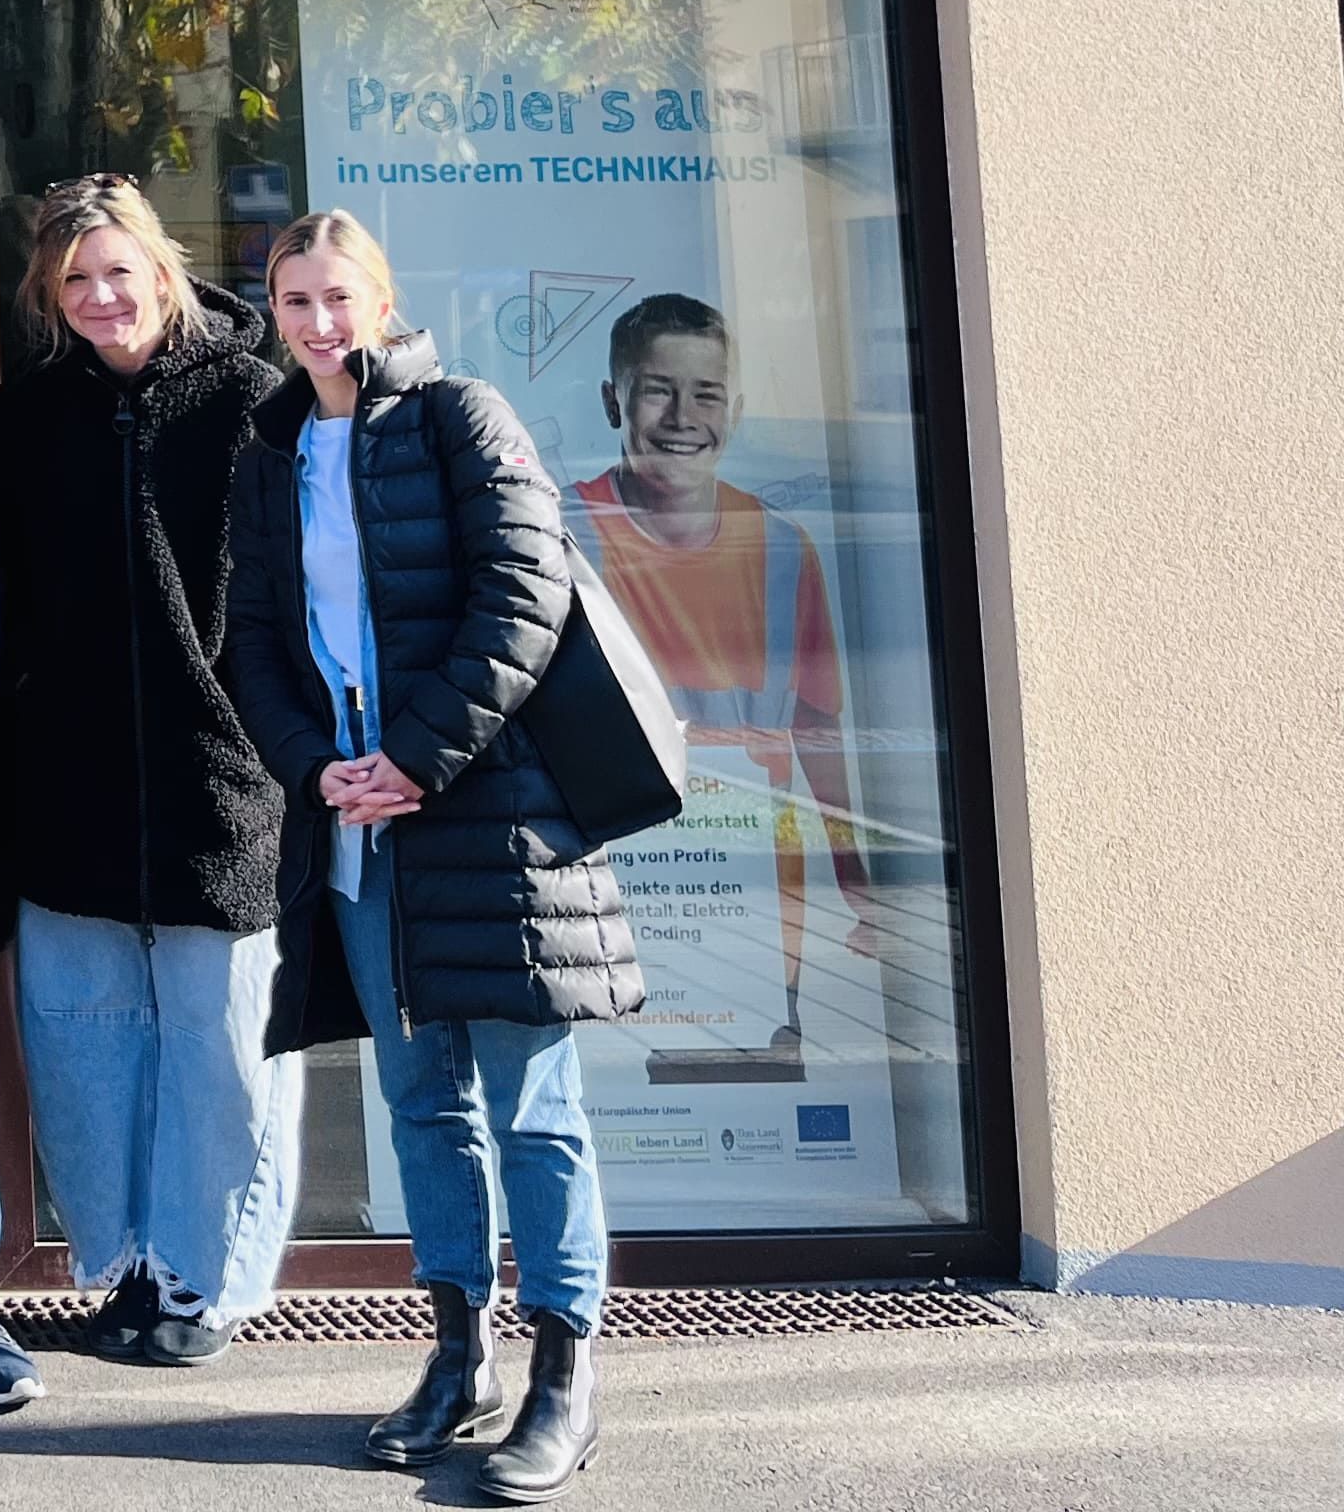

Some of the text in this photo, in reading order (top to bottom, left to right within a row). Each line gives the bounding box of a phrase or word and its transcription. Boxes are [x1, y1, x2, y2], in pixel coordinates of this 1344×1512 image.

[654, 86, 763, 134] aus
[337, 156, 777, 184] in unserem TECHNIKHAUS!
[673, 813, 760, 829] Werkstatt
[638, 852, 670, 864] von
[674, 848, 728, 863] Profis
[675, 883, 706, 895] aus
[710, 880, 743, 895] den
[682, 903, 750, 919] Elektro,
[640, 925, 702, 943] Coding
[646, 989, 688, 1002] unter
[635, 1136, 670, 1148] leben
[673, 1136, 704, 1148] Land
